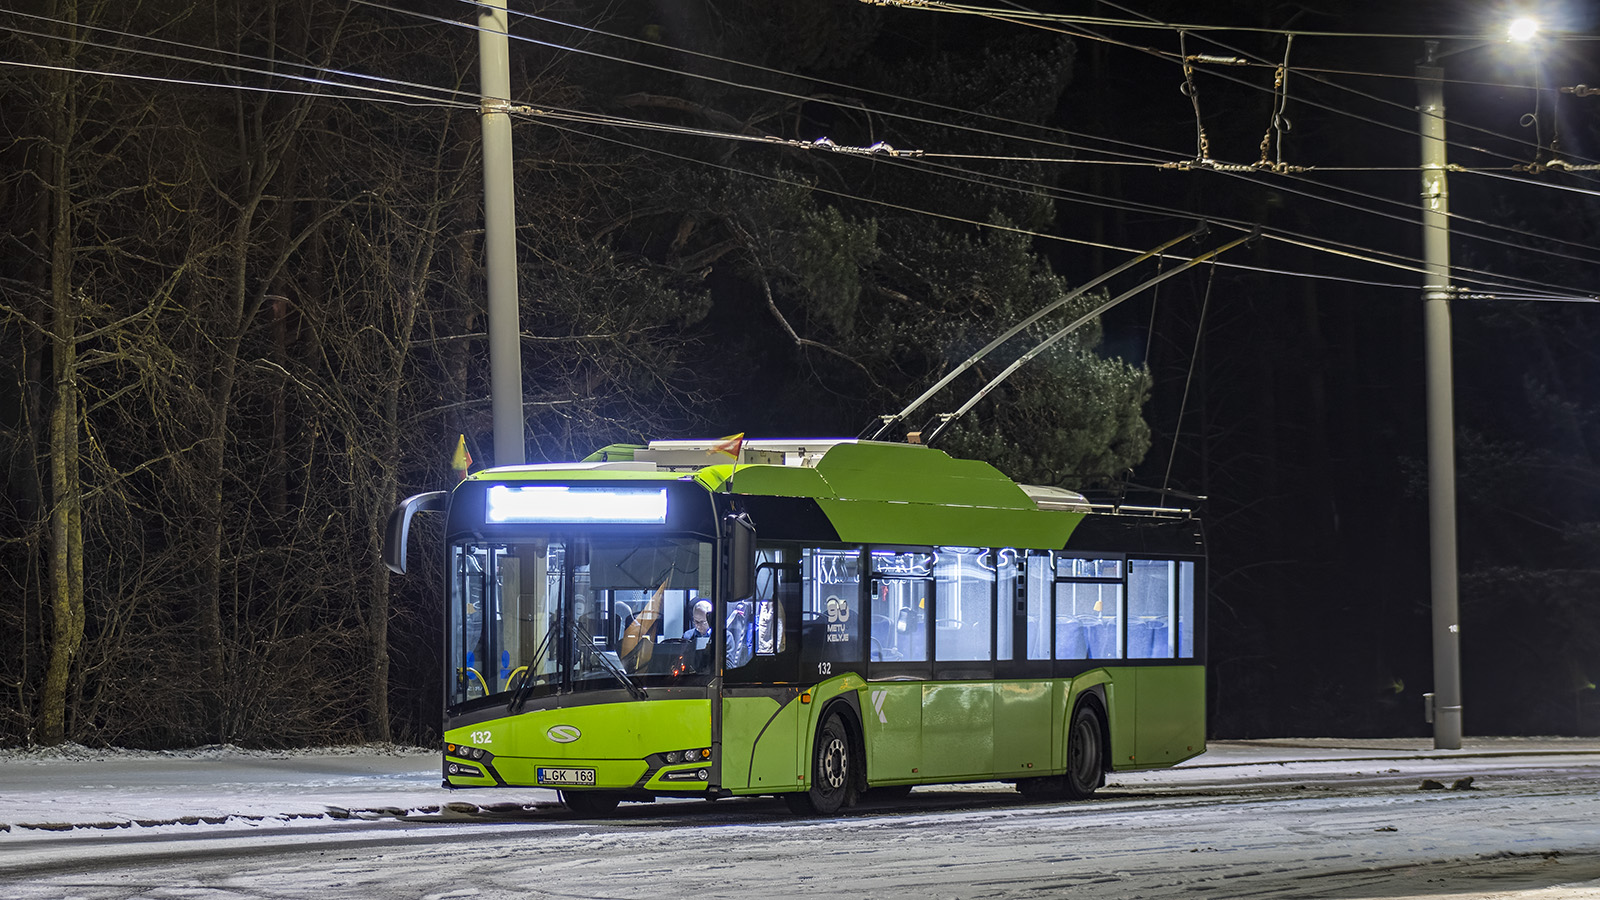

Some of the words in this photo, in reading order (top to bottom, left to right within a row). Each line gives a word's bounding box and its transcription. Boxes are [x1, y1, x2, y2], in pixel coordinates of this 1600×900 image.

[827, 633, 849, 642] KELYJE
[817, 662, 832, 675] 132
[470, 731, 492, 744] 132
[544, 770, 567, 781] LGK
[574, 771, 593, 782] 163
